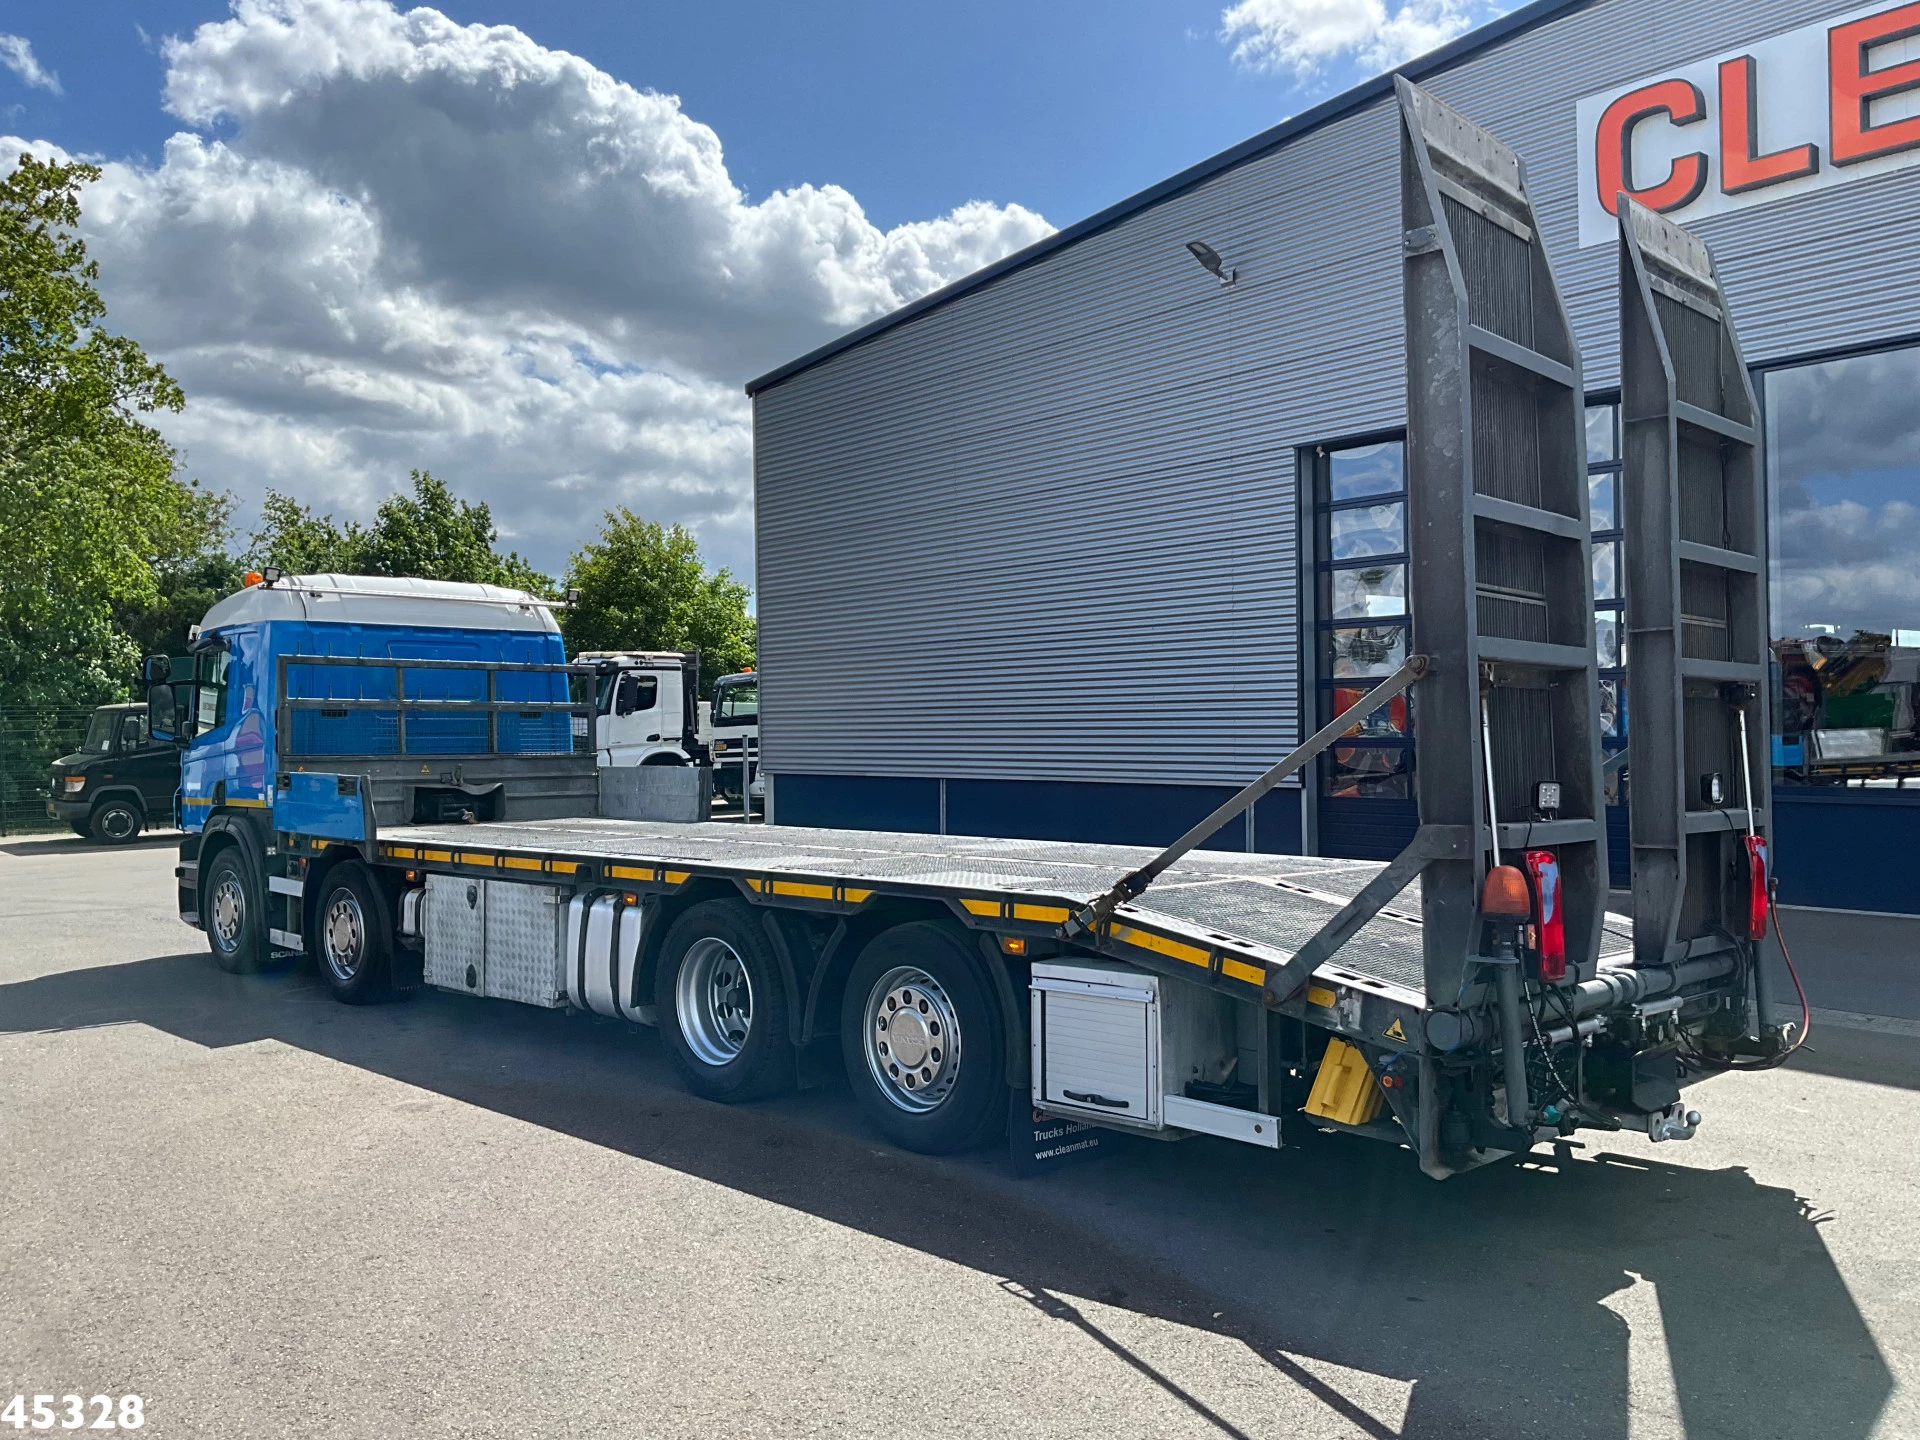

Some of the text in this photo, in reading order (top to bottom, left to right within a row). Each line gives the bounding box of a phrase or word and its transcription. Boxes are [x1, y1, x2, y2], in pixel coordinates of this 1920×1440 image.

[1595, 2, 1920, 217] CLE
[1034, 1128, 1064, 1142] Trucks
[1035, 1138, 1099, 1160] www.cleanmat.eu
